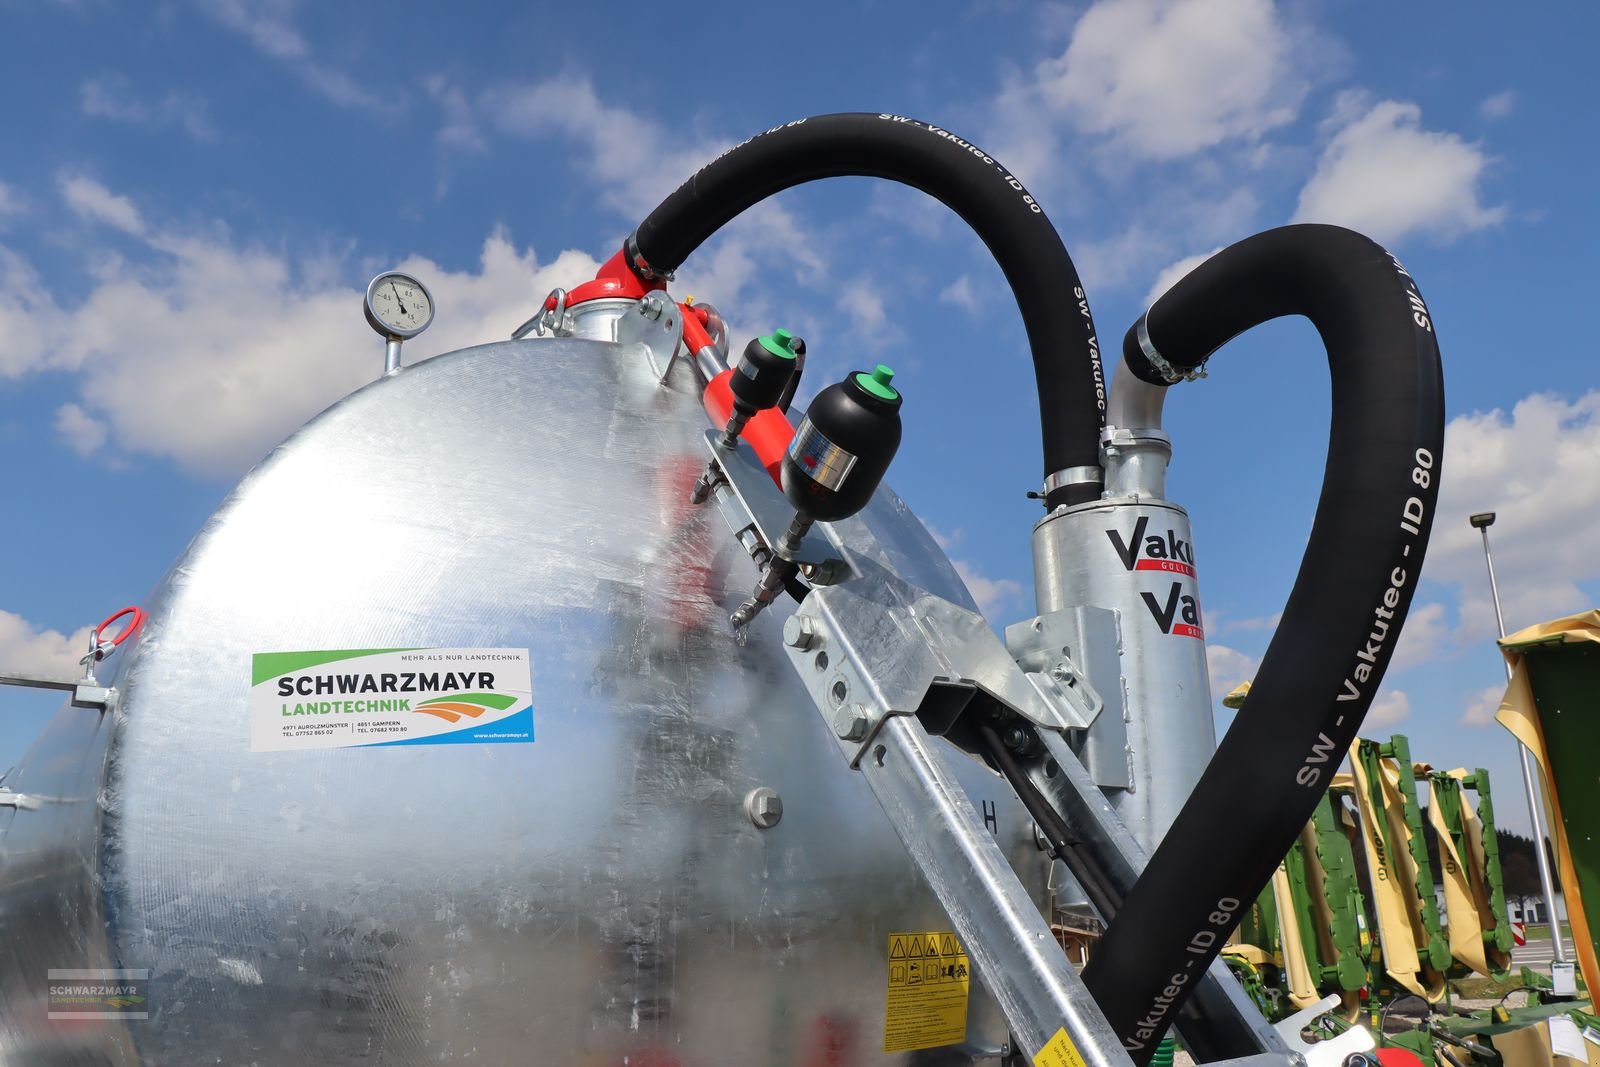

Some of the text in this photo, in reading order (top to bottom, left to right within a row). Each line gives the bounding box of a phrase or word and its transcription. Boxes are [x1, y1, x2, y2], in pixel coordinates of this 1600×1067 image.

[879, 113, 912, 123] SW
[928, 124, 994, 165] Vakutec
[1004, 175, 1022, 191] ID
[1023, 194, 1041, 213] 80
[1407, 289, 1431, 332] SW
[1074, 286, 1090, 318] SW
[1088, 336, 1105, 410] Vakutec
[1296, 732, 1335, 787] SW
[1336, 567, 1407, 701] Vakutec
[1400, 497, 1424, 535] ID
[1412, 448, 1433, 489] 80
[277, 672, 496, 697] SCHWARZMAYR
[281, 698, 411, 717] LANDTECHNIK
[297, 722, 349, 730] AUROLZMÜNSTER
[1124, 973, 1189, 1051] Vakutec
[1186, 930, 1216, 954] ID
[1208, 897, 1240, 925] 80
